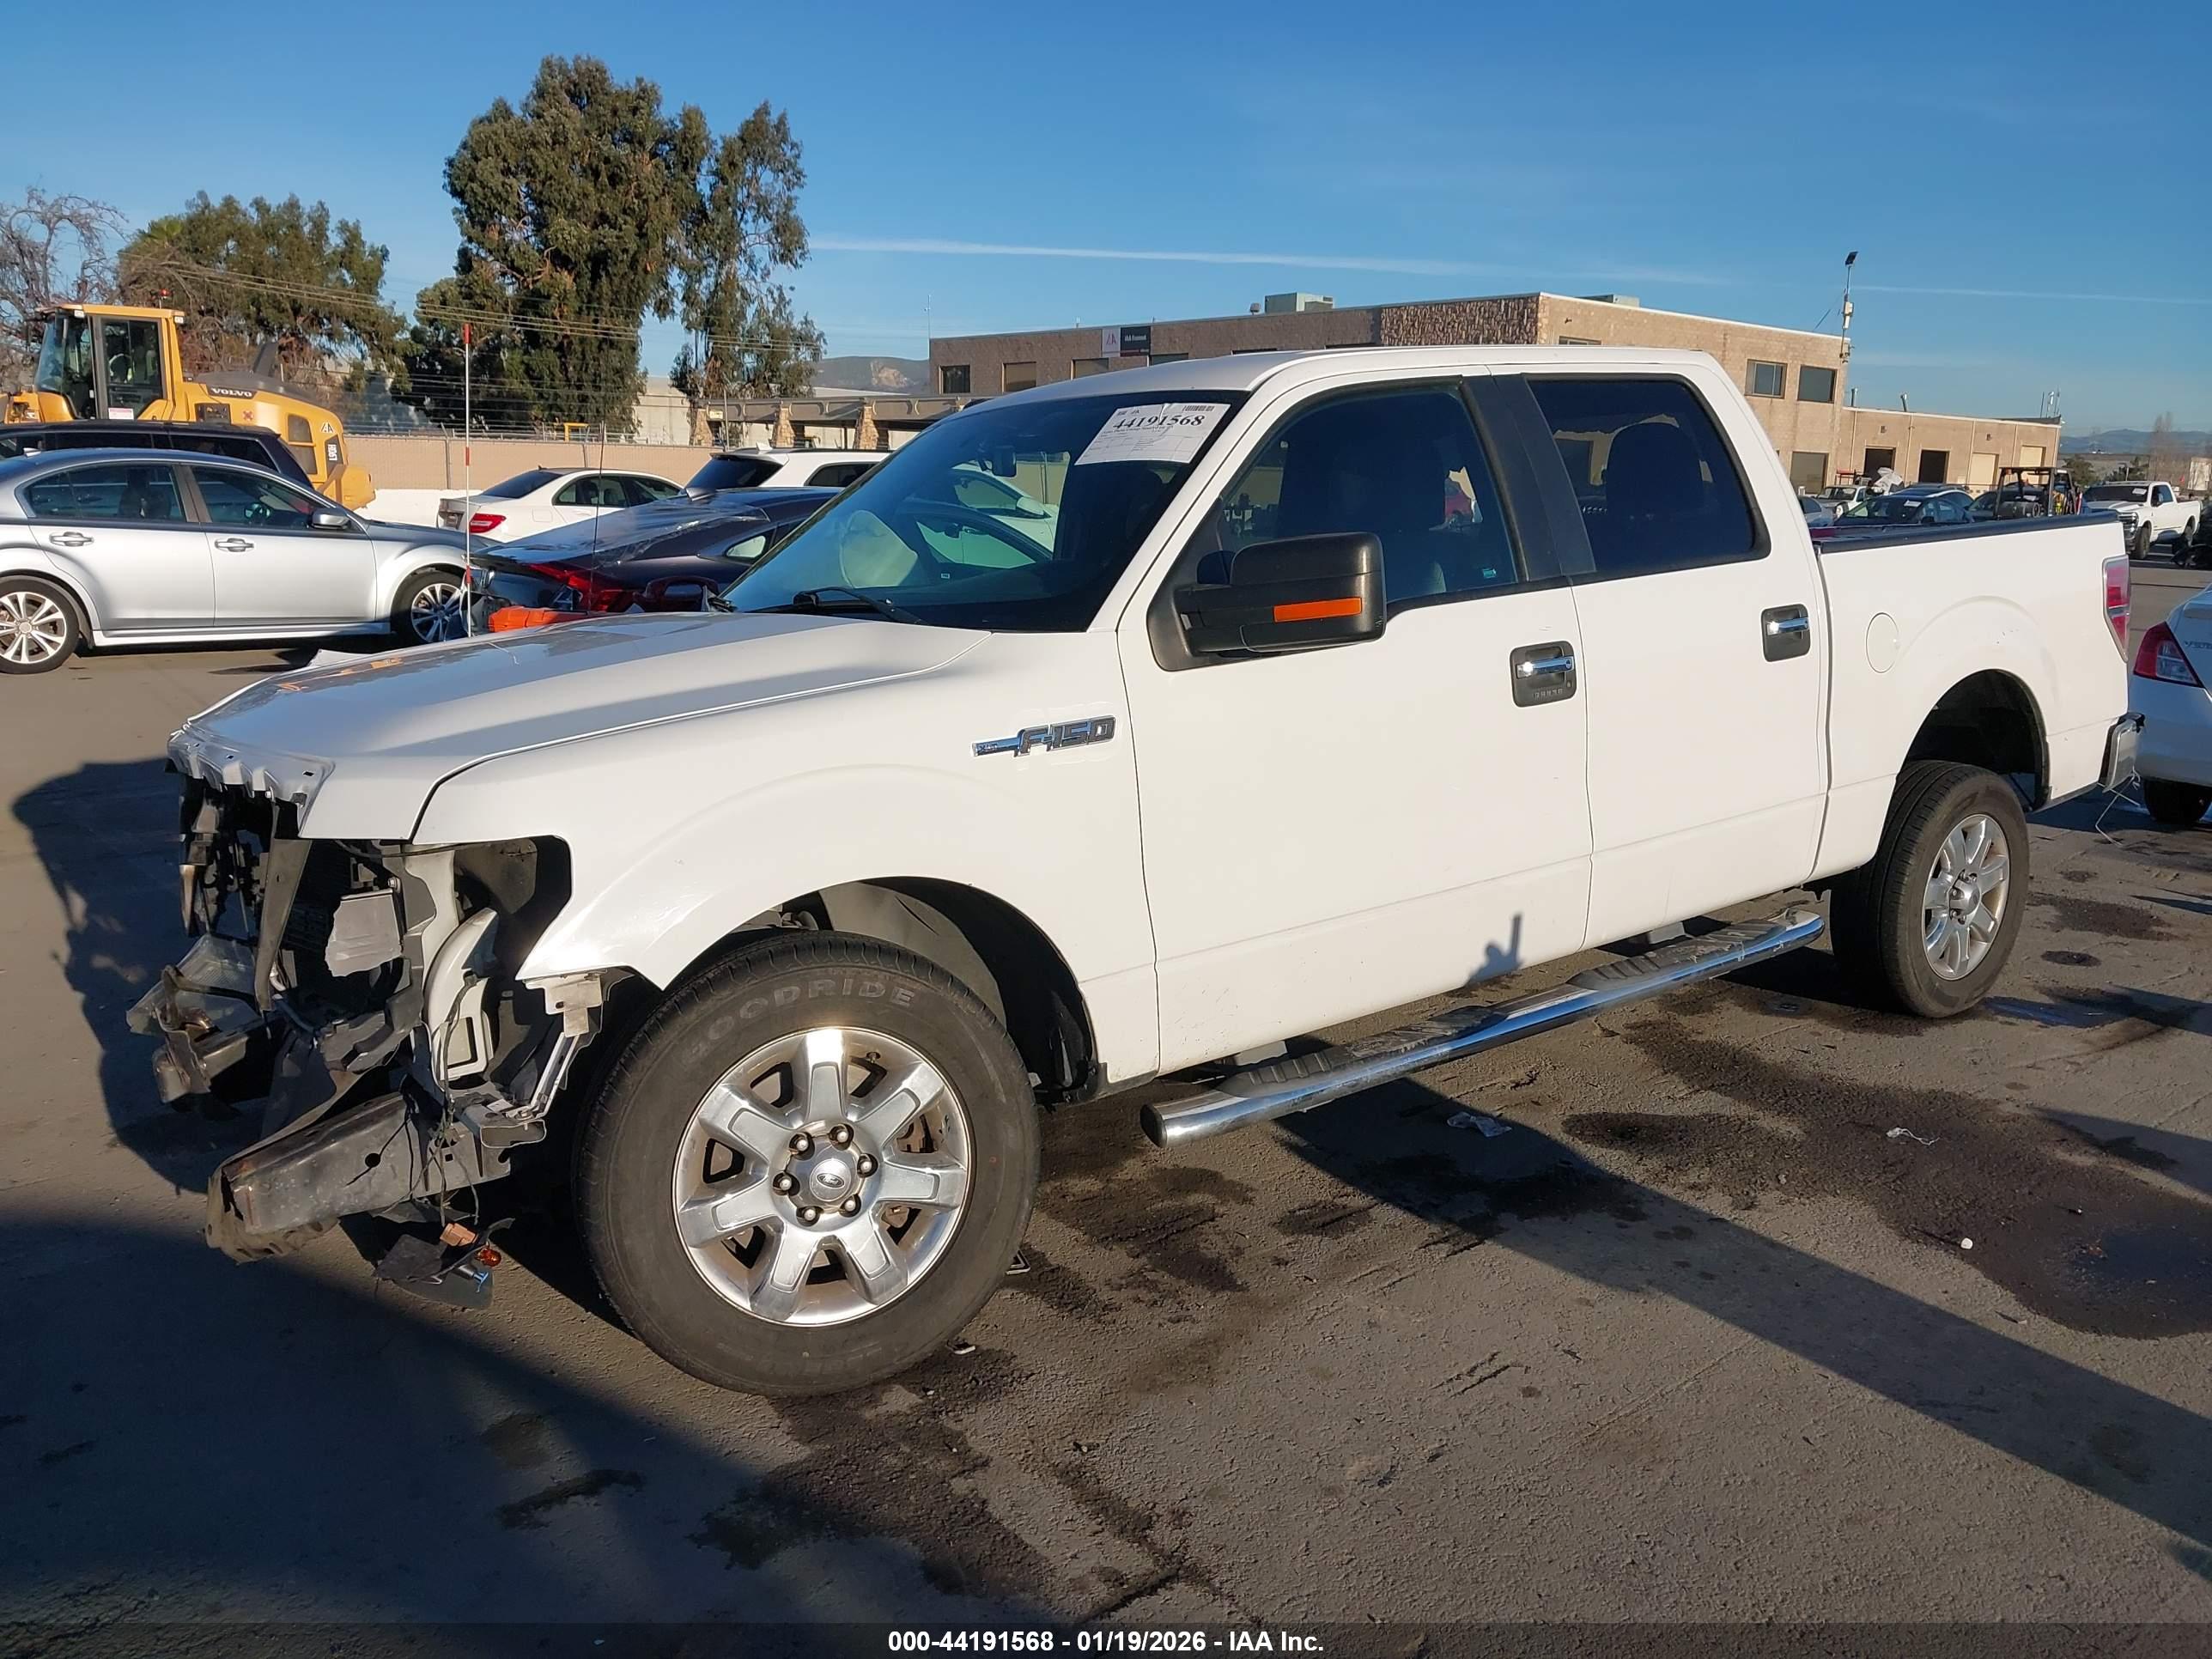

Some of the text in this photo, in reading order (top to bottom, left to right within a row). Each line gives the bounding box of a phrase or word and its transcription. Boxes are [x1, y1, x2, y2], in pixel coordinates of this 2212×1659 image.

[211, 387, 252, 398] VOLVO
[1113, 415, 1205, 428] 44191568
[327, 444, 337, 461] L90H
